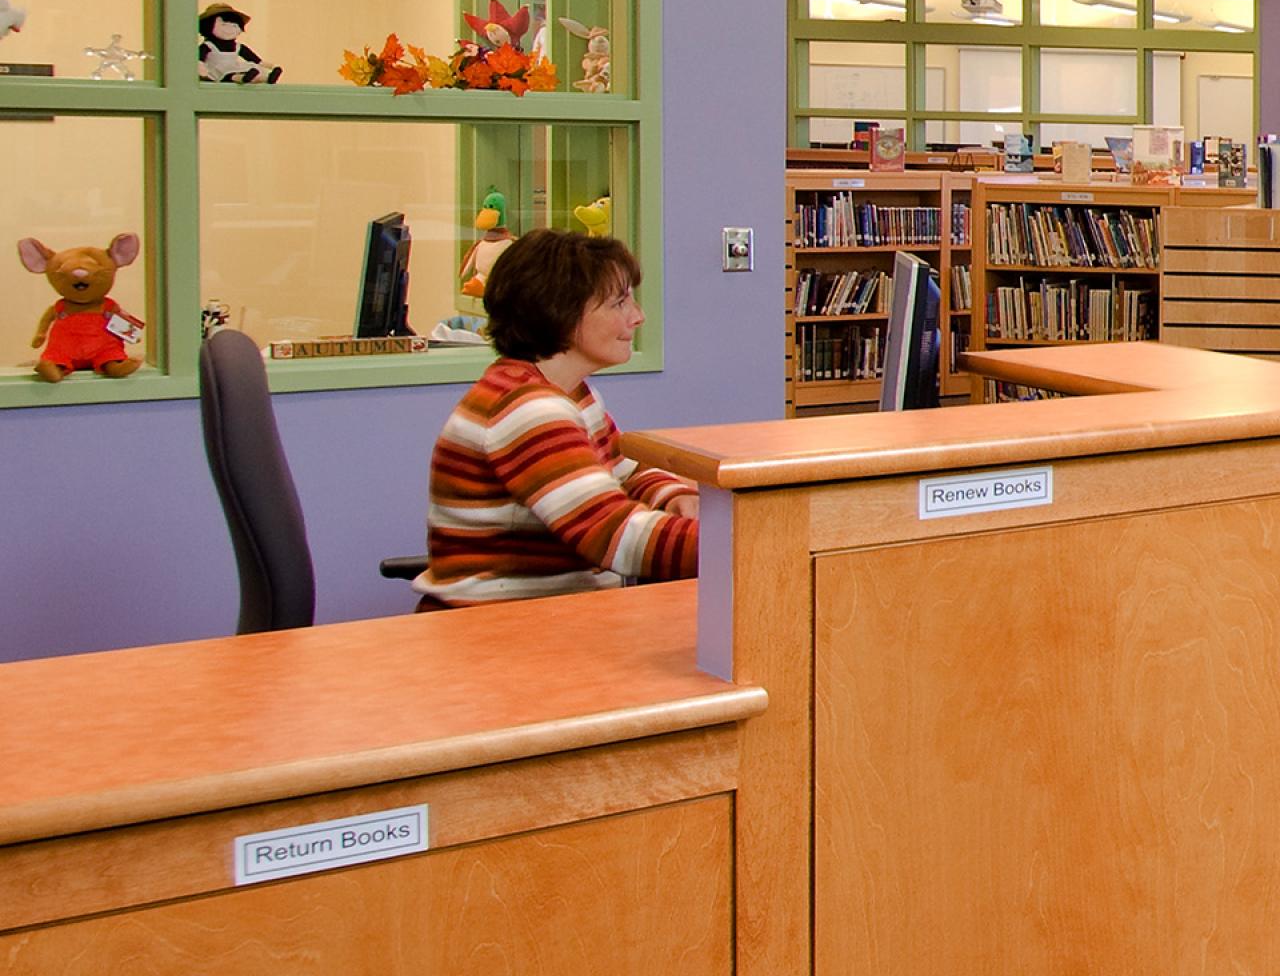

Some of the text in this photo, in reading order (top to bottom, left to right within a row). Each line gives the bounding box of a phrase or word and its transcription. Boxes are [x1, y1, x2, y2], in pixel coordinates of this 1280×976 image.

[296, 338, 406, 356] AUTUMN
[932, 480, 1042, 504] Renew Books
[255, 824, 411, 865] Return Books
